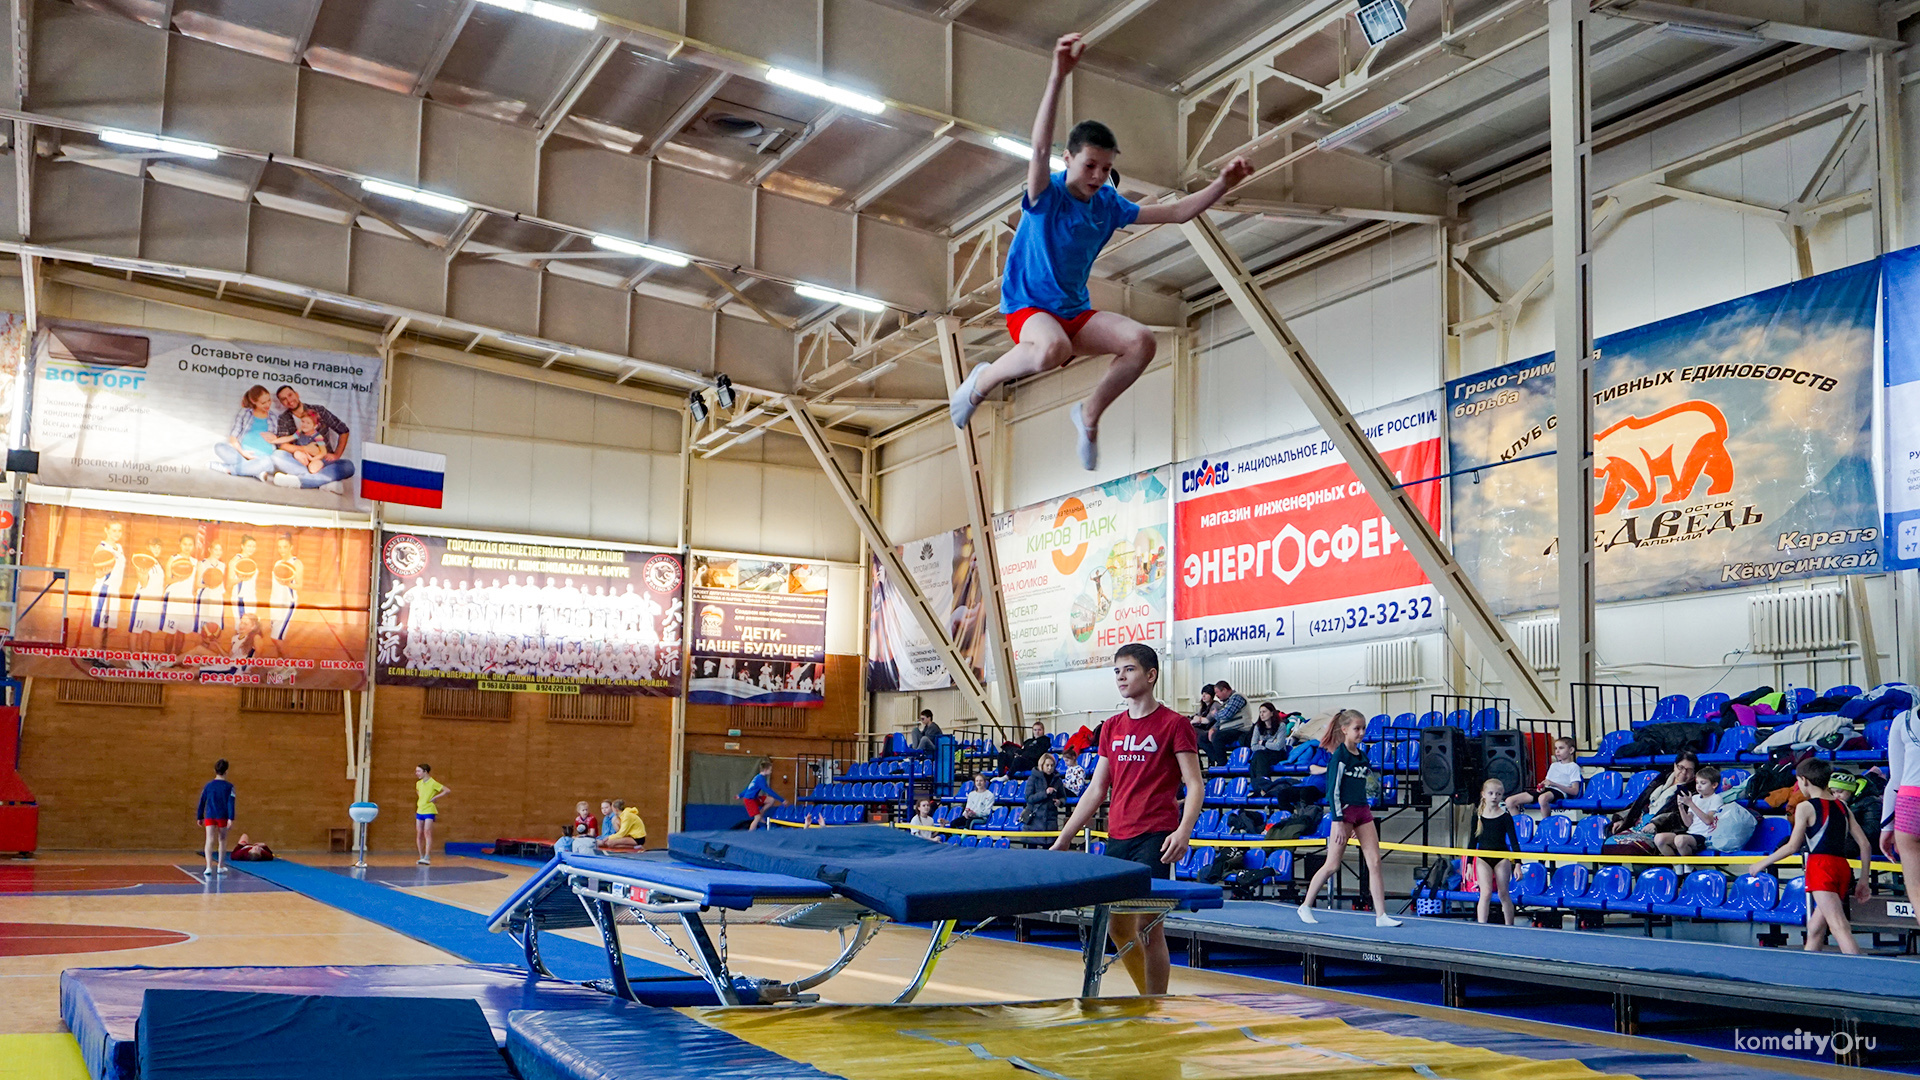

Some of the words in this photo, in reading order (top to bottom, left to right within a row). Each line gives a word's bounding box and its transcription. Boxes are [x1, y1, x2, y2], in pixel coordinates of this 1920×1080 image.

[191, 344, 253, 362] Оставьте
[256, 354, 290, 366] силы
[294, 360, 309, 369] на
[312, 362, 363, 376] главное
[45, 367, 145, 390] ВОСТОРГ
[178, 359, 188, 371] О
[192, 362, 259, 379] комфорте
[263, 371, 347, 390] позаботимся
[351, 381, 373, 393] мы!
[1454, 348, 1602, 400] Греко-римя
[1454, 390, 1520, 418] борьба
[1500, 426, 1543, 463] КЛУБ
[1680, 364, 1839, 393] ЕДИНОБОРСТВ
[1237, 443, 1318, 474] НАЦИОНАЛЬНОЕ
[1320, 422, 1384, 456] ДОНИЕ
[71, 457, 118, 468] проспект
[122, 460, 152, 473] Мира,
[156, 465, 177, 473] дом
[180, 465, 190, 474] 10
[108, 473, 149, 486] 51-01-50
[1200, 505, 1251, 529] магазин
[1254, 482, 1346, 519] инженерных
[1685, 500, 1735, 514] ОСТОК
[993, 513, 1015, 532] WI-FI
[1026, 526, 1072, 554] КИРОВ
[1079, 514, 1117, 541] ПАРК
[447, 539, 498, 553] ГОРОДСКАЯ
[499, 543, 565, 559] ОБЩЕСТВЕННАЯ
[566, 547, 624, 563] ОРГАНИЗАЦИЯ
[1777, 527, 1878, 551] Каратэ
[1184, 516, 1408, 588] ЭНЕРГОСФЕР
[518, 559, 630, 578] КОМСОМОЛЬСКА-НА-АМУРЕ
[1721, 548, 1879, 582] Кёкусинкай
[168, 620, 175, 629] 12
[1115, 604, 1150, 621] СКУЧНО
[1019, 623, 1058, 639] АВТОМАТЫ
[1098, 628, 1115, 647] НЕ
[1118, 621, 1166, 645] БУДЕТ
[1196, 623, 1271, 648] Гаражная,
[1276, 616, 1285, 637] 2
[14, 646, 176, 663] Специализированная
[184, 654, 314, 669] детско-юношеская
[320, 660, 365, 670] школа
[696, 639, 740, 653] НАШЕ
[90, 667, 194, 681] олимпийского
[201, 672, 260, 684] резерва
[290, 674, 296, 685] 1
[388, 667, 405, 675] ЕСЛИ
[406, 668, 417, 676] НЕТ
[419, 669, 445, 679] ДОРОГИ
[446, 671, 477, 680] ВПЕРЕДИ
[493, 673, 506, 681] ОНА
[507, 674, 535, 682] ДОЛЖНА
[536, 675, 574, 684] ОСТАВАТЬСЯ
[1111, 734, 1158, 752] FILA
